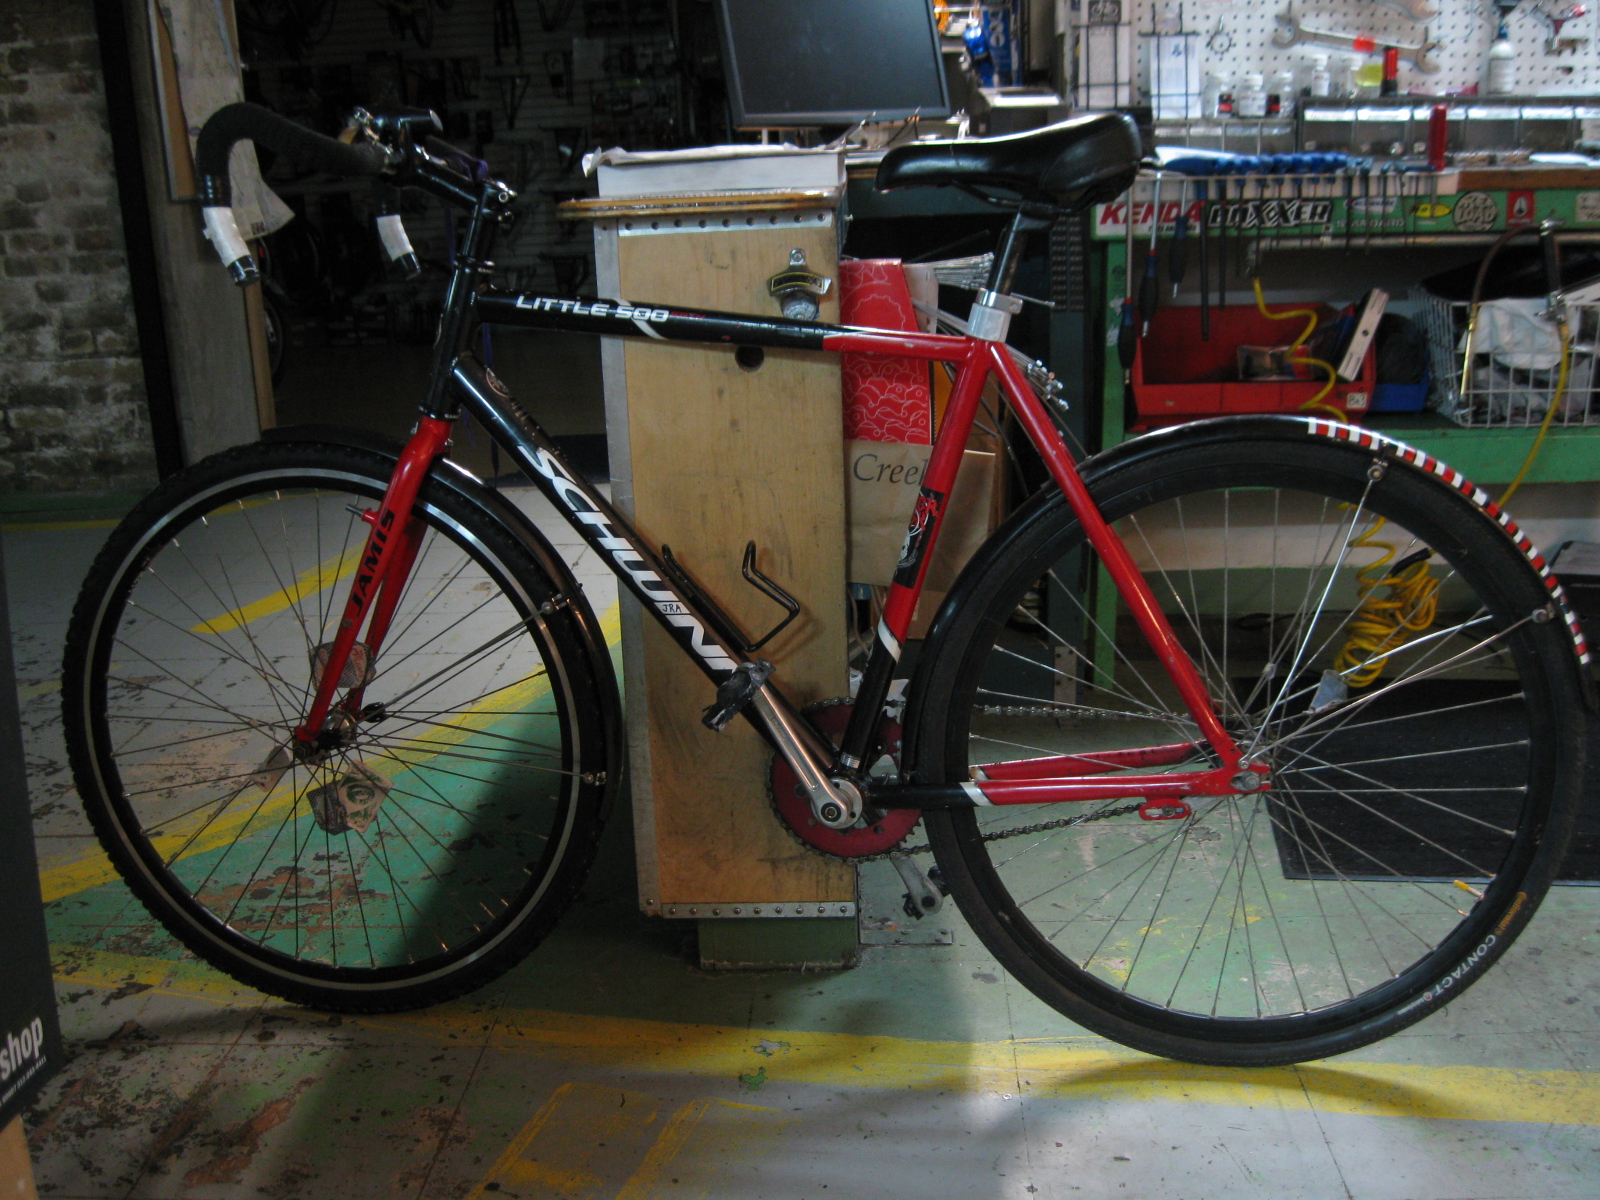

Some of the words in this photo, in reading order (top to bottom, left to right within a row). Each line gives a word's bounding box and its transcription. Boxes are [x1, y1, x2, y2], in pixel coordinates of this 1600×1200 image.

[1100, 201, 1202, 225] KENDA
[515, 294, 610, 317] LITTLE
[614, 304, 670, 323] 500
[352, 509, 395, 618] JAMIS
[662, 603, 682, 613] JRA
[1433, 934, 1496, 996] CONTACT
[0, 1016, 44, 1081] shop
